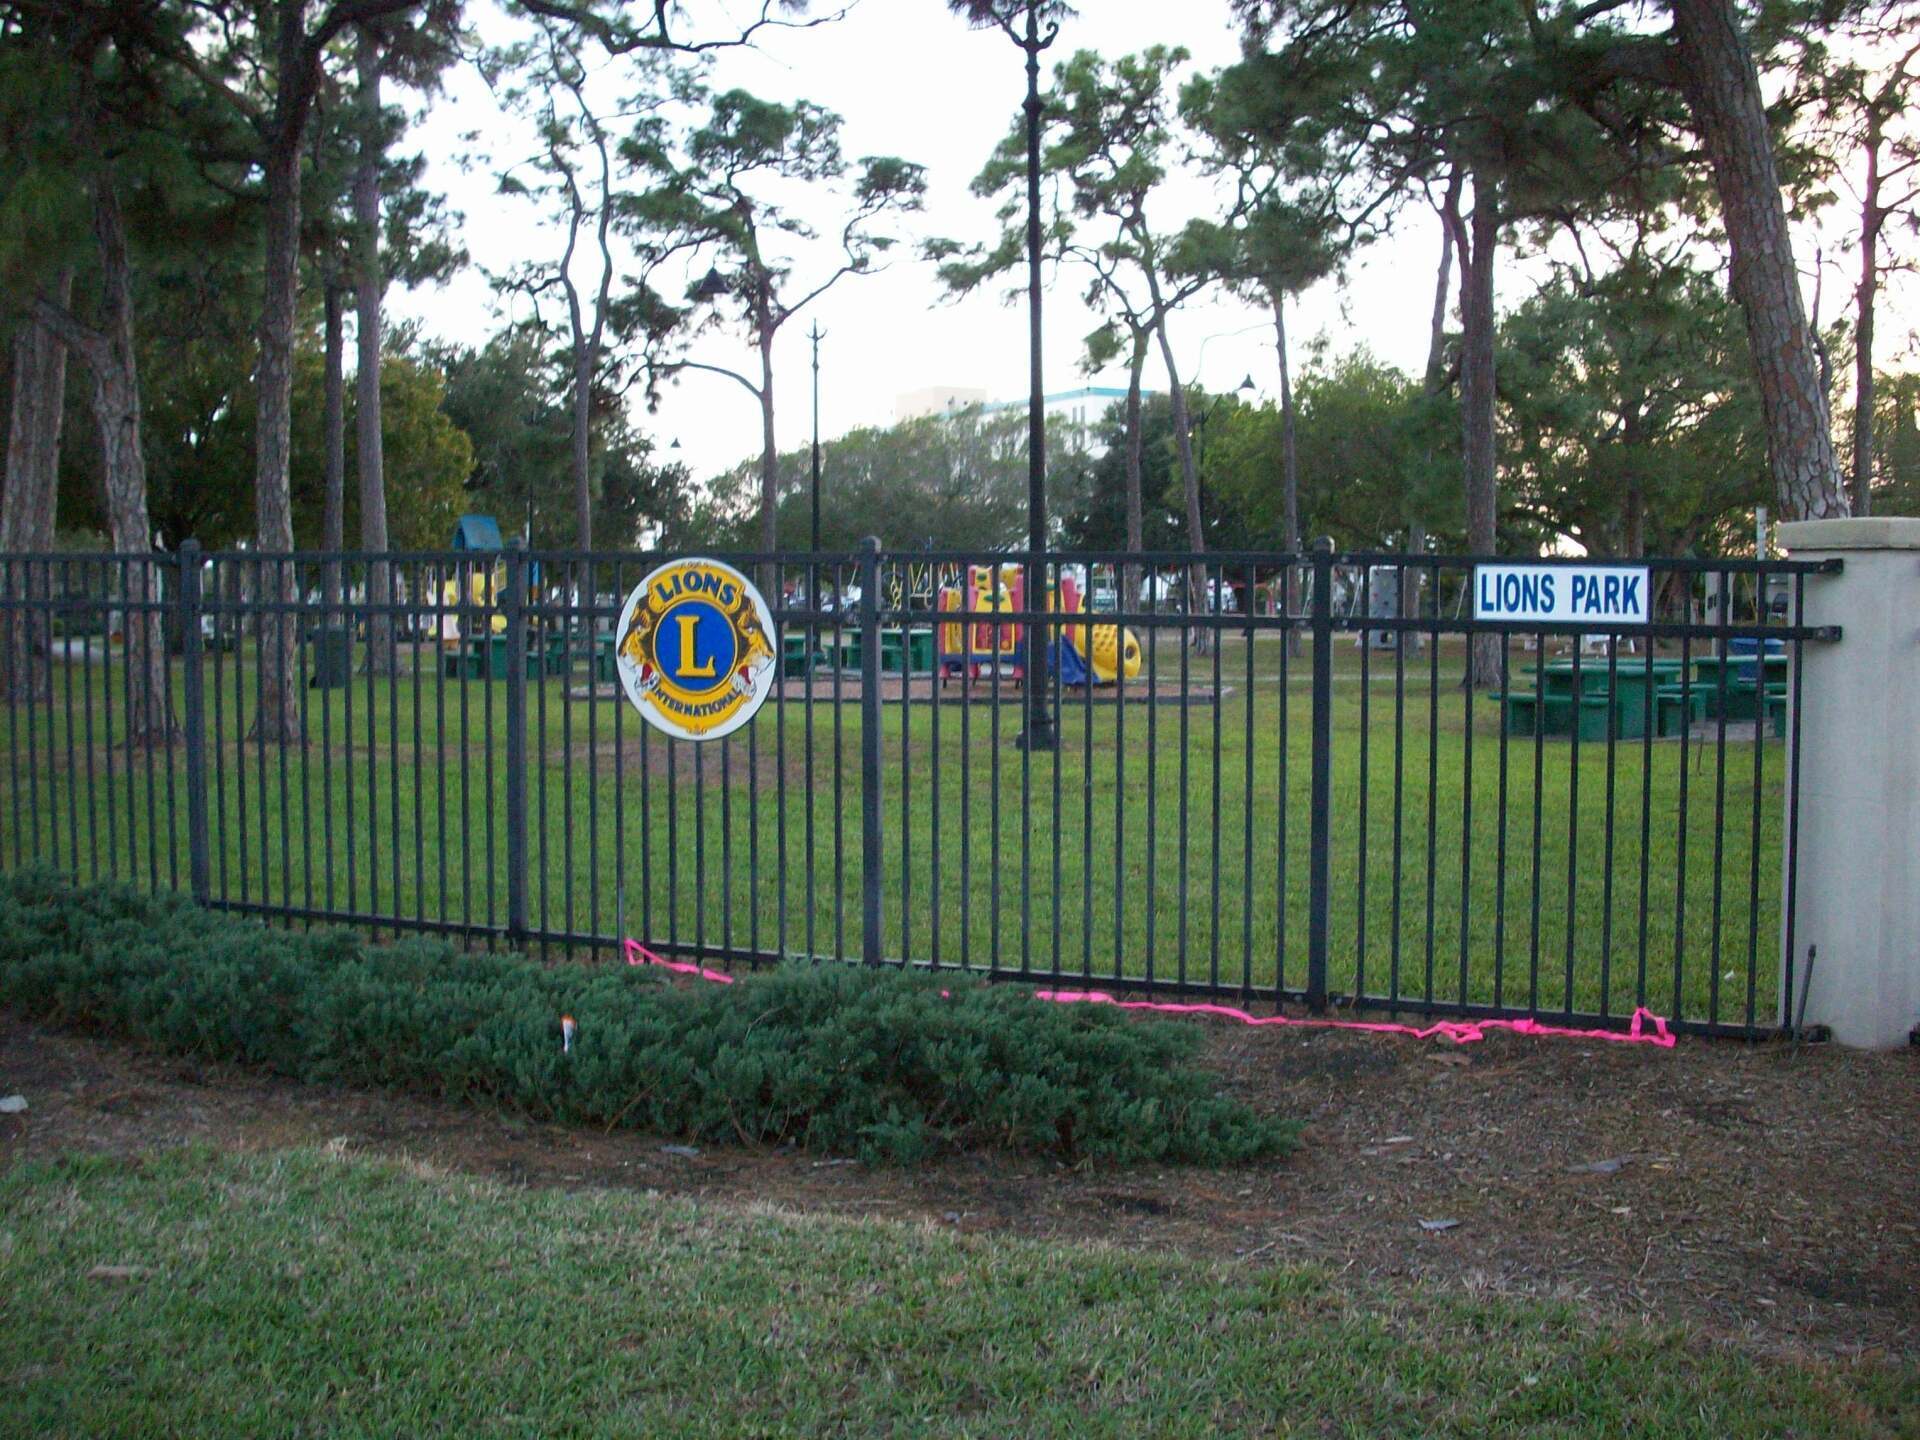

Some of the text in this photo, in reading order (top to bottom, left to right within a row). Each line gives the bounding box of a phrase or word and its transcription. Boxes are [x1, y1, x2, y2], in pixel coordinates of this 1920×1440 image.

[655, 571, 737, 605] LIONS
[1481, 573, 1641, 615] LIONS PARK
[675, 615, 716, 677] L
[652, 686, 742, 716] INTERNATIONAL
